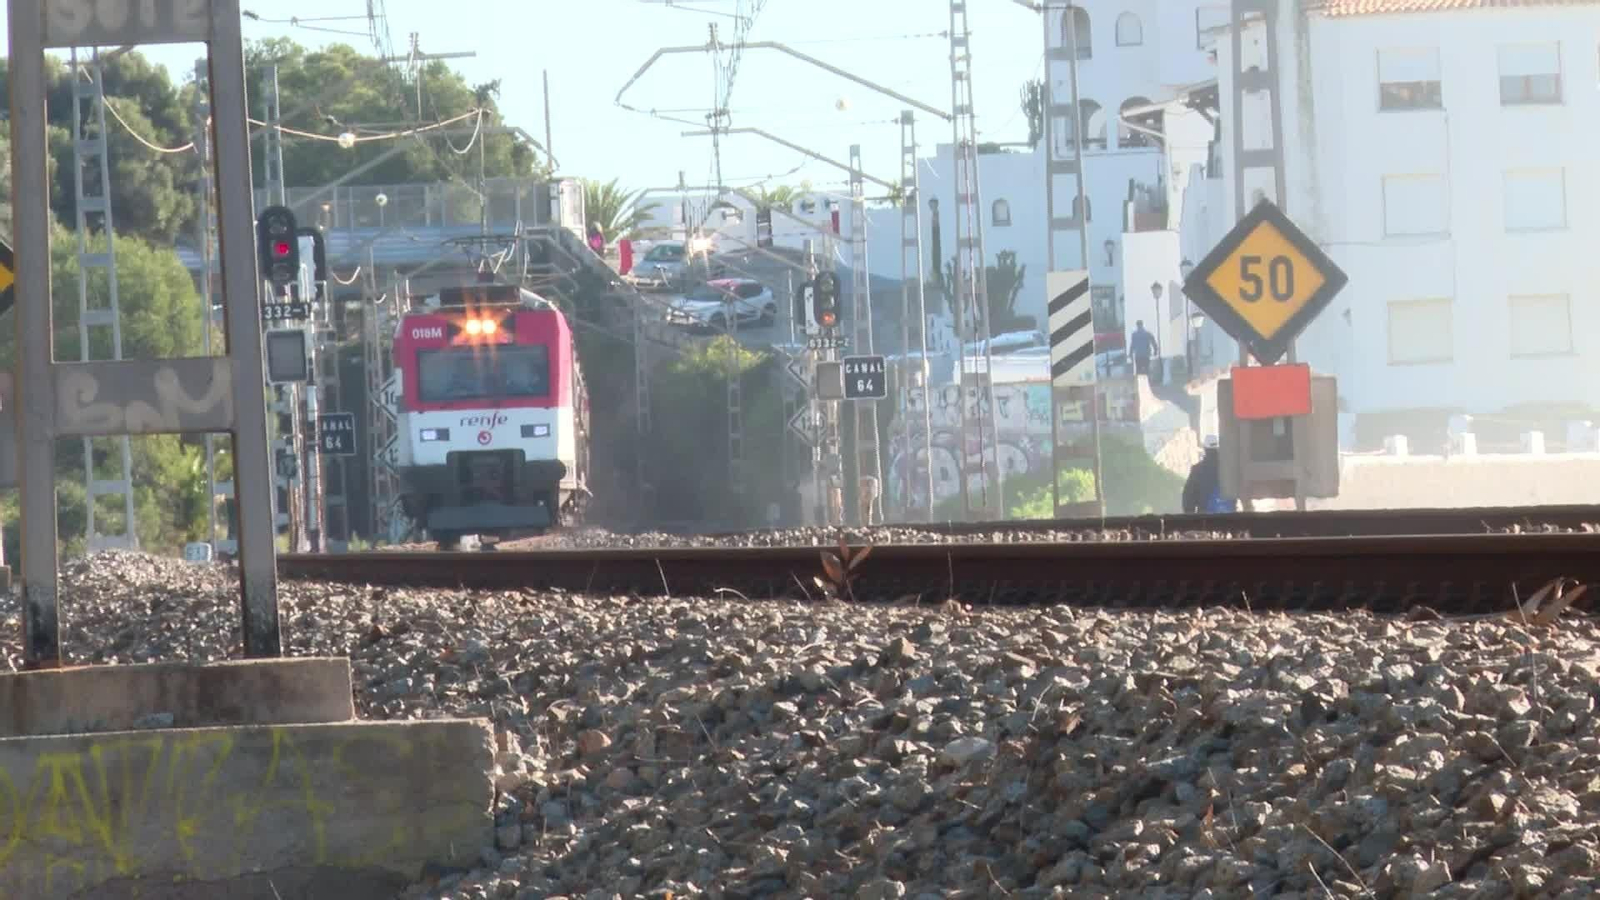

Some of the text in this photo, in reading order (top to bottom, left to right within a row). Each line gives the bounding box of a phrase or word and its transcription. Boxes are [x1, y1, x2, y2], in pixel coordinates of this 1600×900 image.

[1239, 255, 1294, 303] 50
[264, 305, 310, 319] 332-1
[845, 362, 884, 374] CANAL
[857, 379, 874, 392] 64
[322, 419, 352, 431] ANAL
[460, 411, 508, 428] renfe
[325, 435, 342, 449] 64
